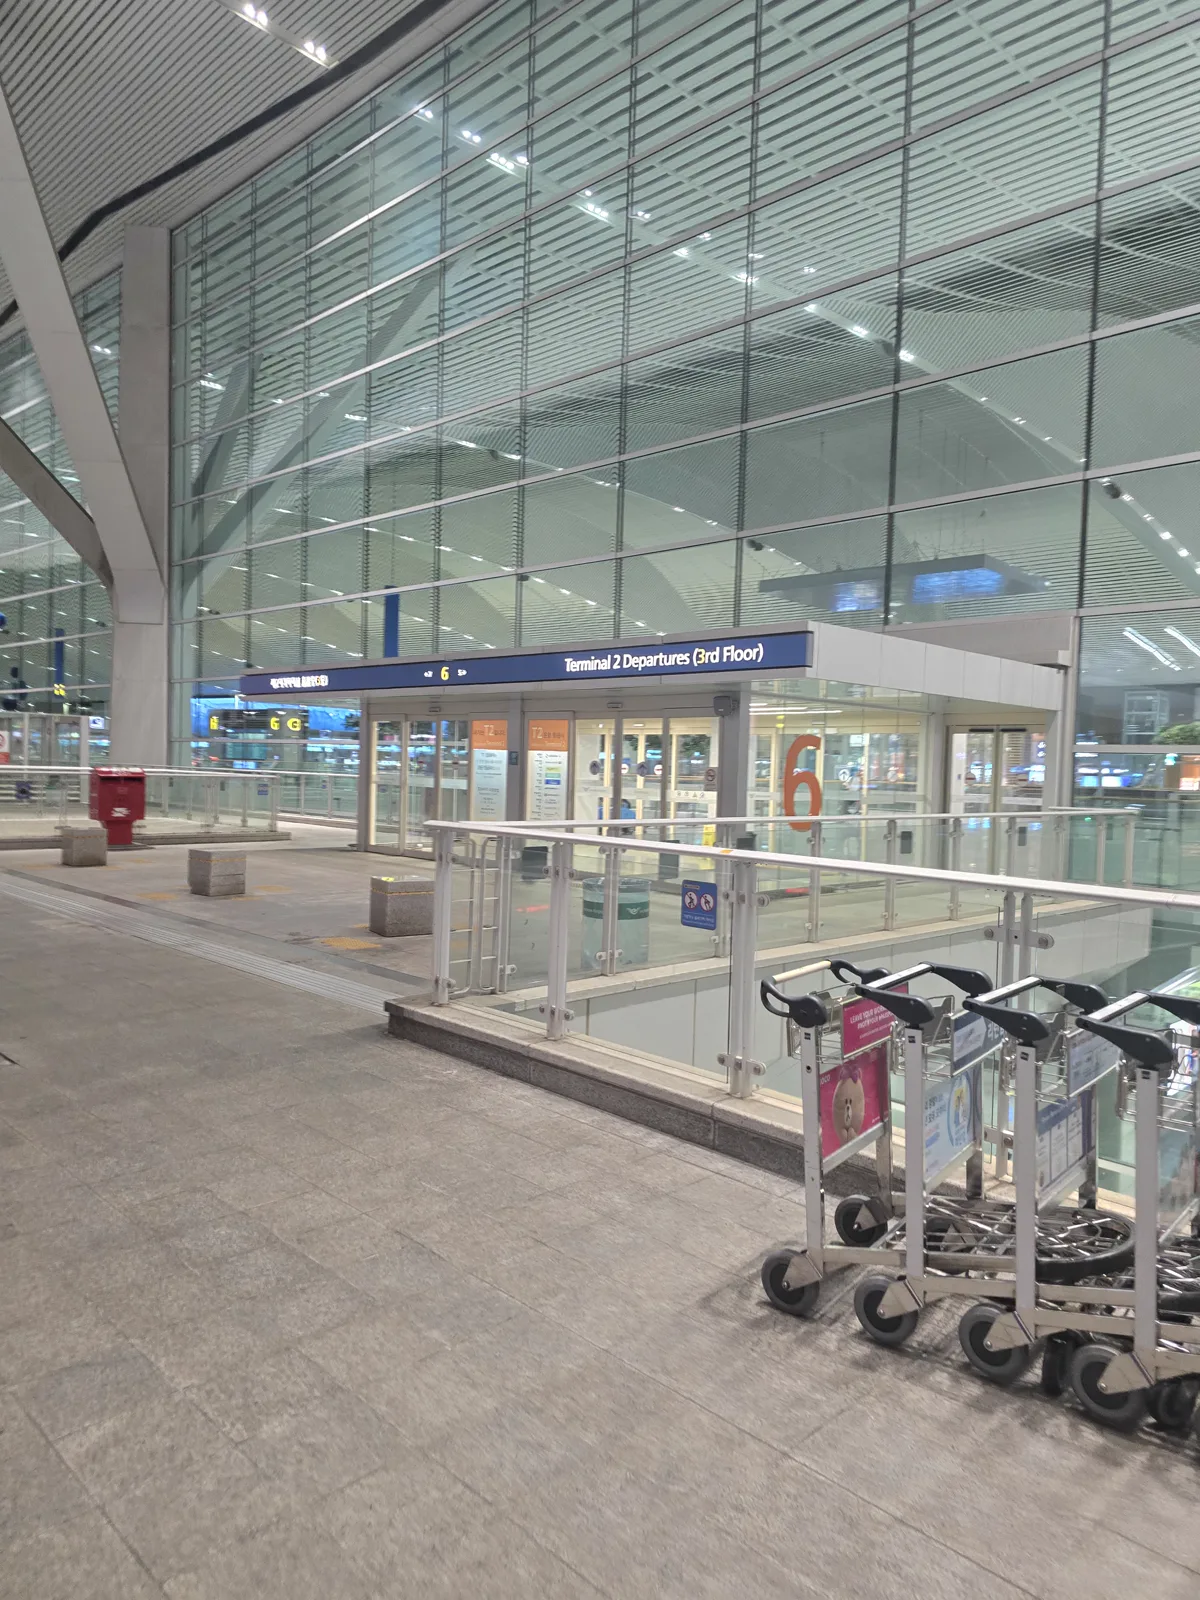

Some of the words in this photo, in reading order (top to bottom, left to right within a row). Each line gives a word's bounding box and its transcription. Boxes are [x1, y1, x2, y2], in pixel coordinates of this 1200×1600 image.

[564, 655, 611, 672] Terminal
[613, 655, 621, 669] 2
[623, 652, 690, 671] Departures
[692, 646, 720, 666] (3rd
[723, 643, 764, 663] Floor)
[441, 666, 450, 681] 6
[483, 724, 495, 736] T2
[532, 726, 544, 739] T2
[784, 734, 822, 832] 6
